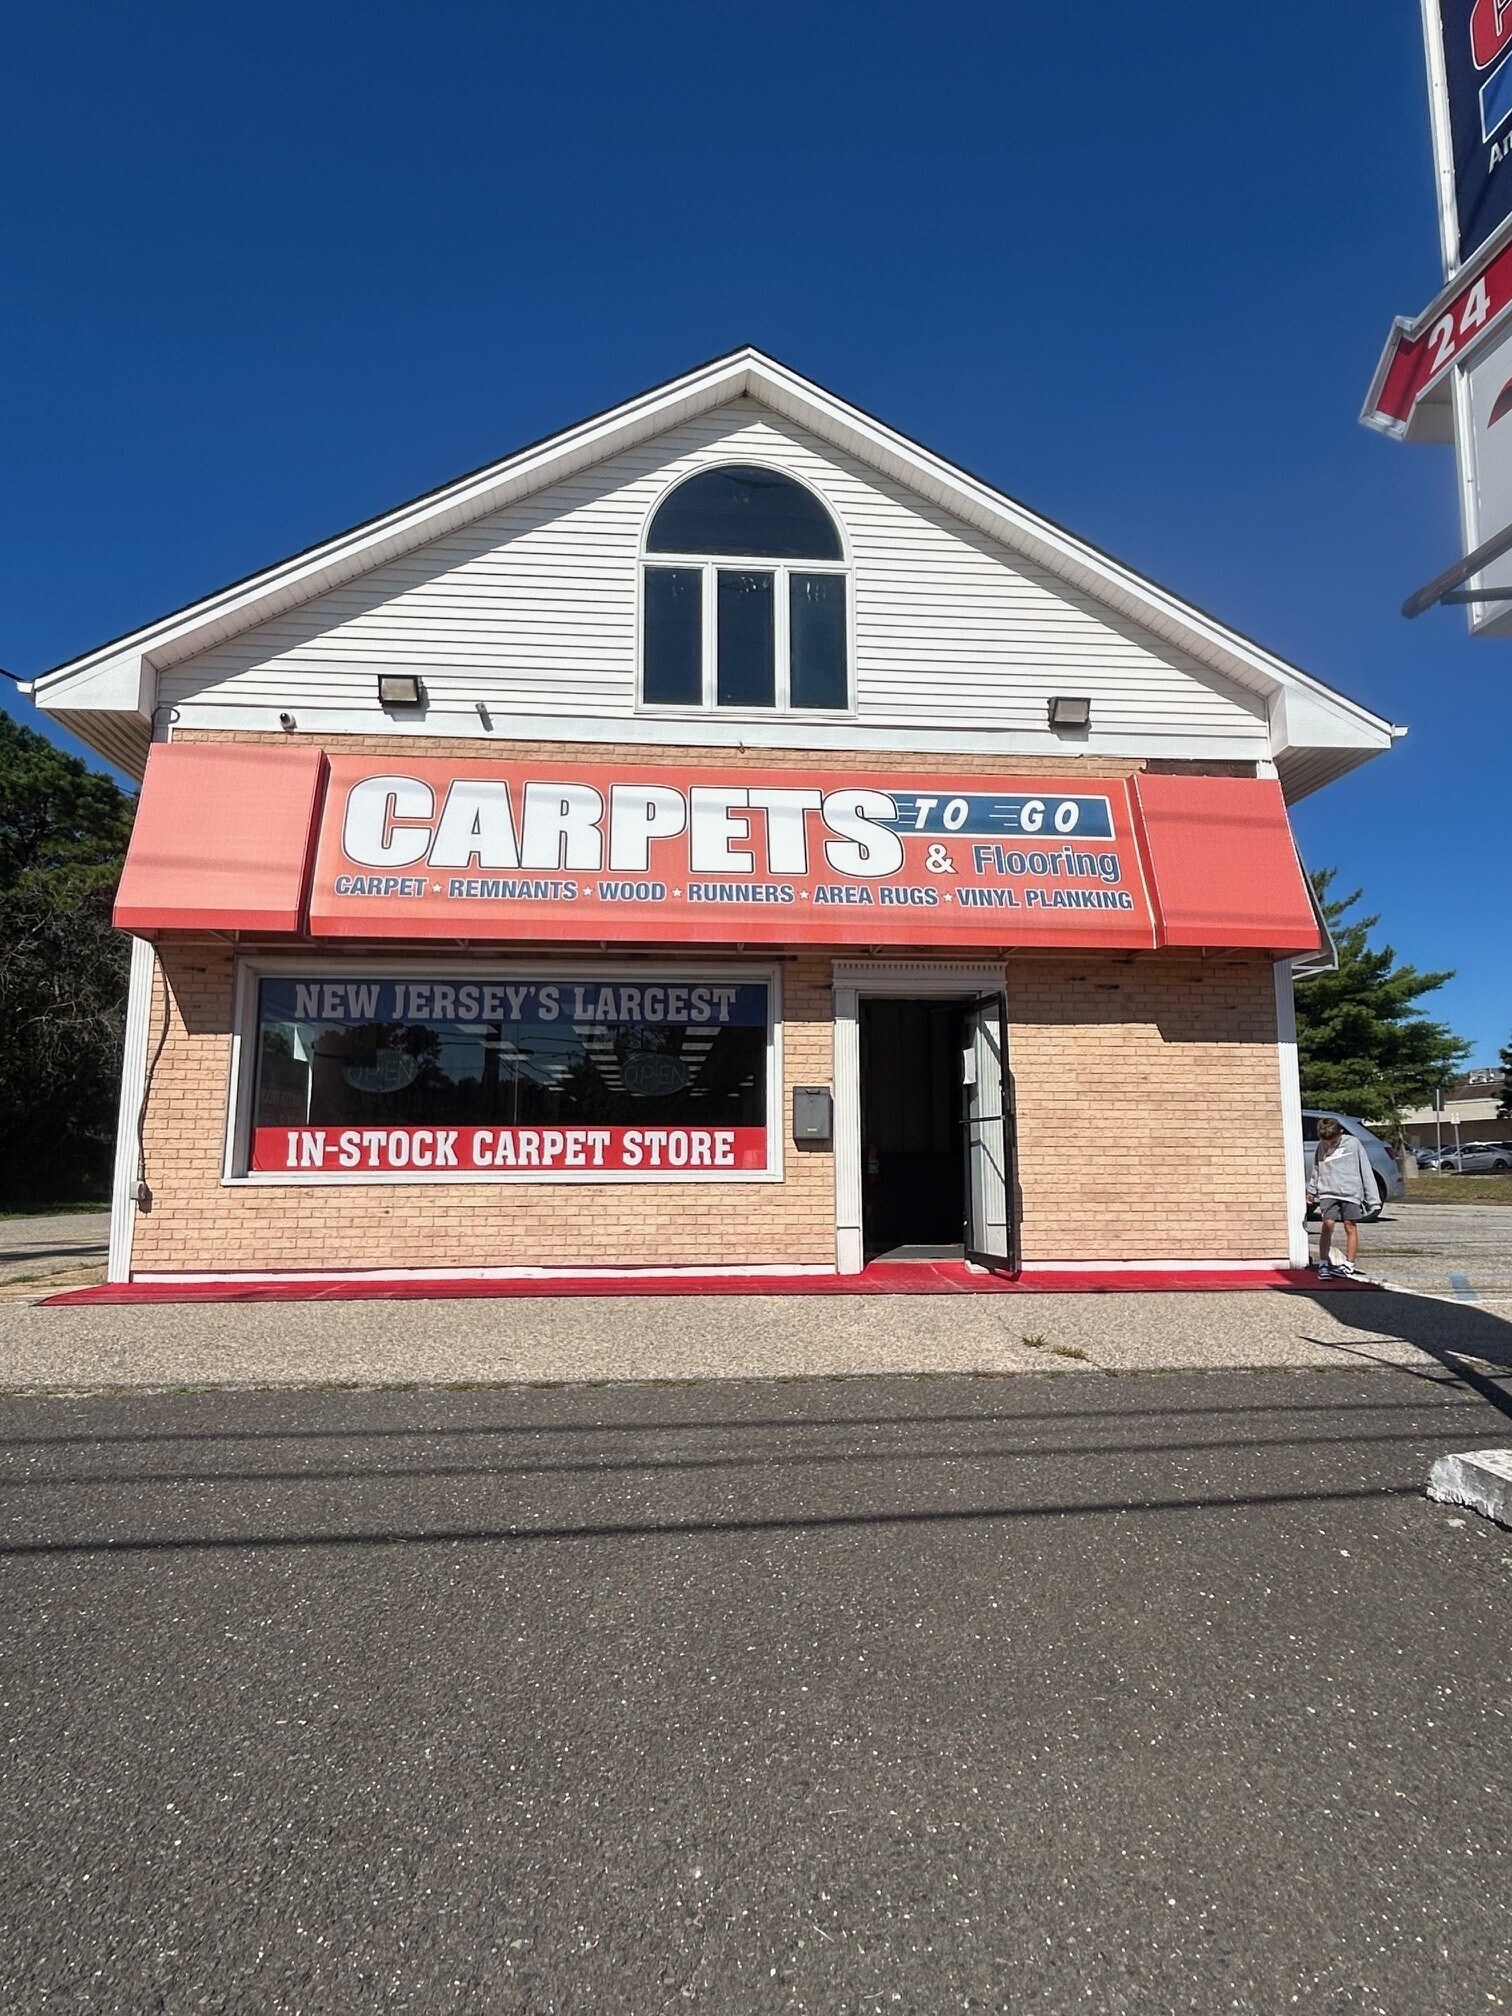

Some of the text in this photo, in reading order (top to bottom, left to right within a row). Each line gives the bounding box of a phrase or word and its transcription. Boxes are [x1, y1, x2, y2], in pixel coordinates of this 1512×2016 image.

[1428, 277, 1491, 374] 24
[343, 775, 1080, 878] CARPETS TO GO
[926, 844, 1121, 884] & Flooring
[336, 876, 1133, 909] CARPET REMNANTS WOOD RUNNERS AREA RUGS VINYL PLANKING
[294, 984, 736, 1022] NEW JERSEY'S LARGEST
[624, 1065, 686, 1086] OPEN
[286, 1130, 735, 1167] IN-STOCK CARPET STORE
